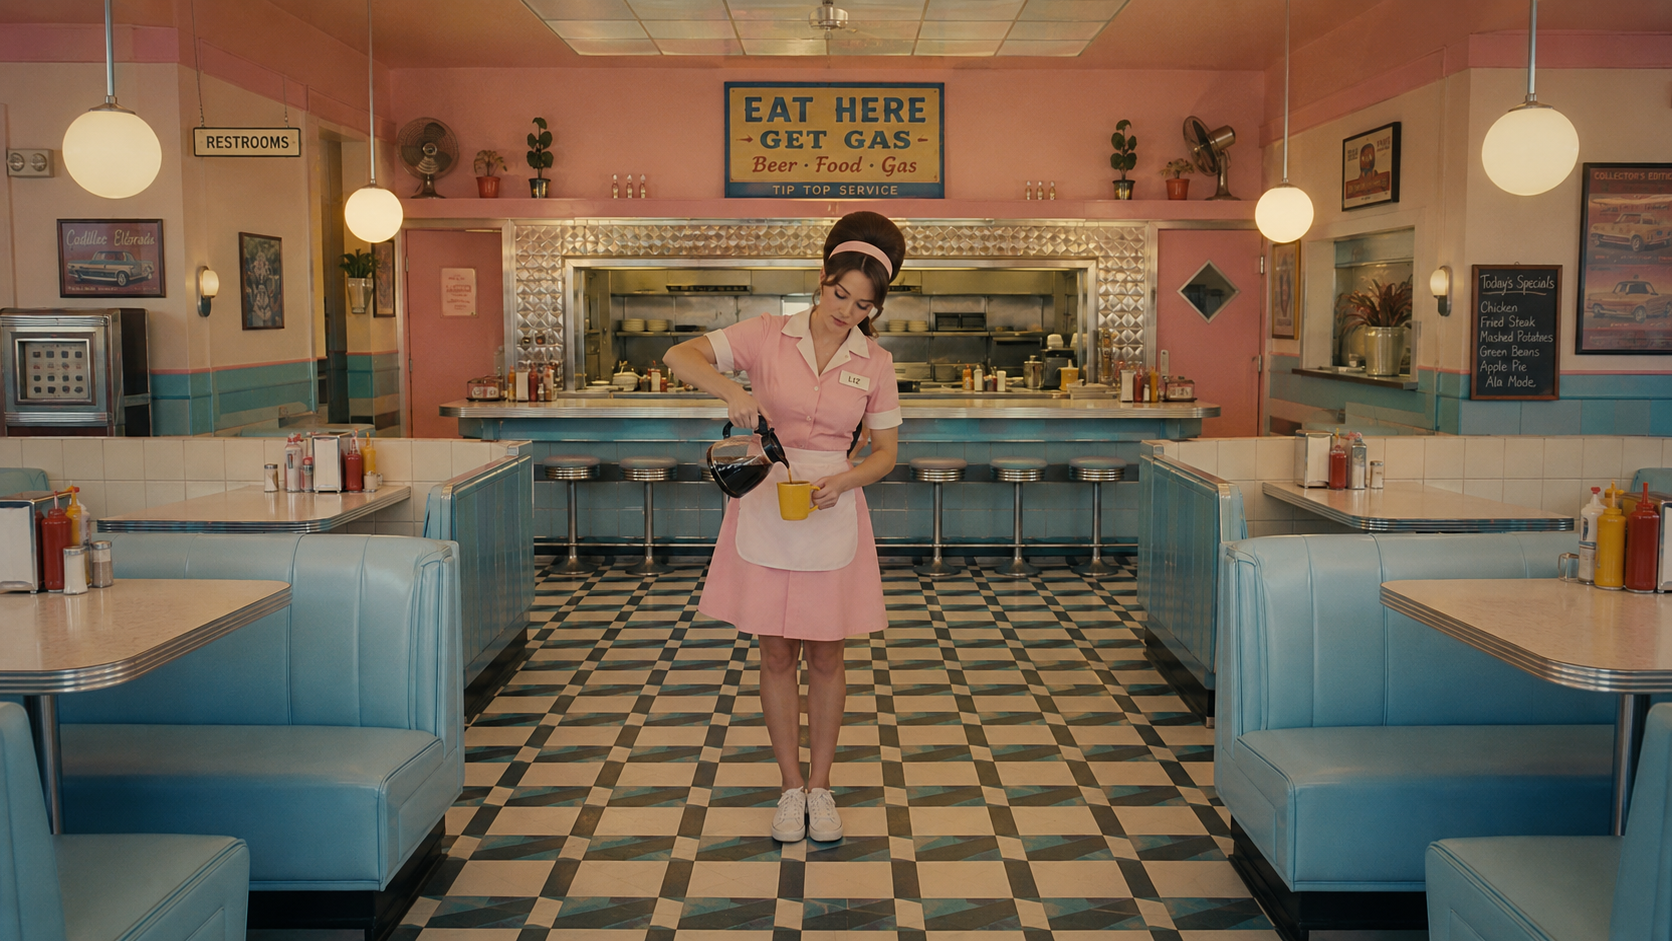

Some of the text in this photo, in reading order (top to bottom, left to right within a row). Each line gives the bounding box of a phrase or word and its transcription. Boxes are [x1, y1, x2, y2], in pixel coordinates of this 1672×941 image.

[744, 97, 926, 123] EAT HERE
[206, 136, 290, 149] RESTROOMS
[760, 130, 911, 150] GET GAS
[752, 156, 917, 177] Beer Food Gas
[772, 185, 898, 196] TIP TOP SERVICE
[1480, 274, 1555, 296] Today's Specials
[1480, 301, 1518, 313] Chicken
[1480, 315, 1536, 328] Fried Steak
[1479, 330, 1514, 343] Mashed
[1479, 345, 1540, 357] Green Beans
[1479, 359, 1527, 375] Apple Pie
[848, 376, 861, 385] LIZ
[1485, 375, 1537, 388] Ala Mode
